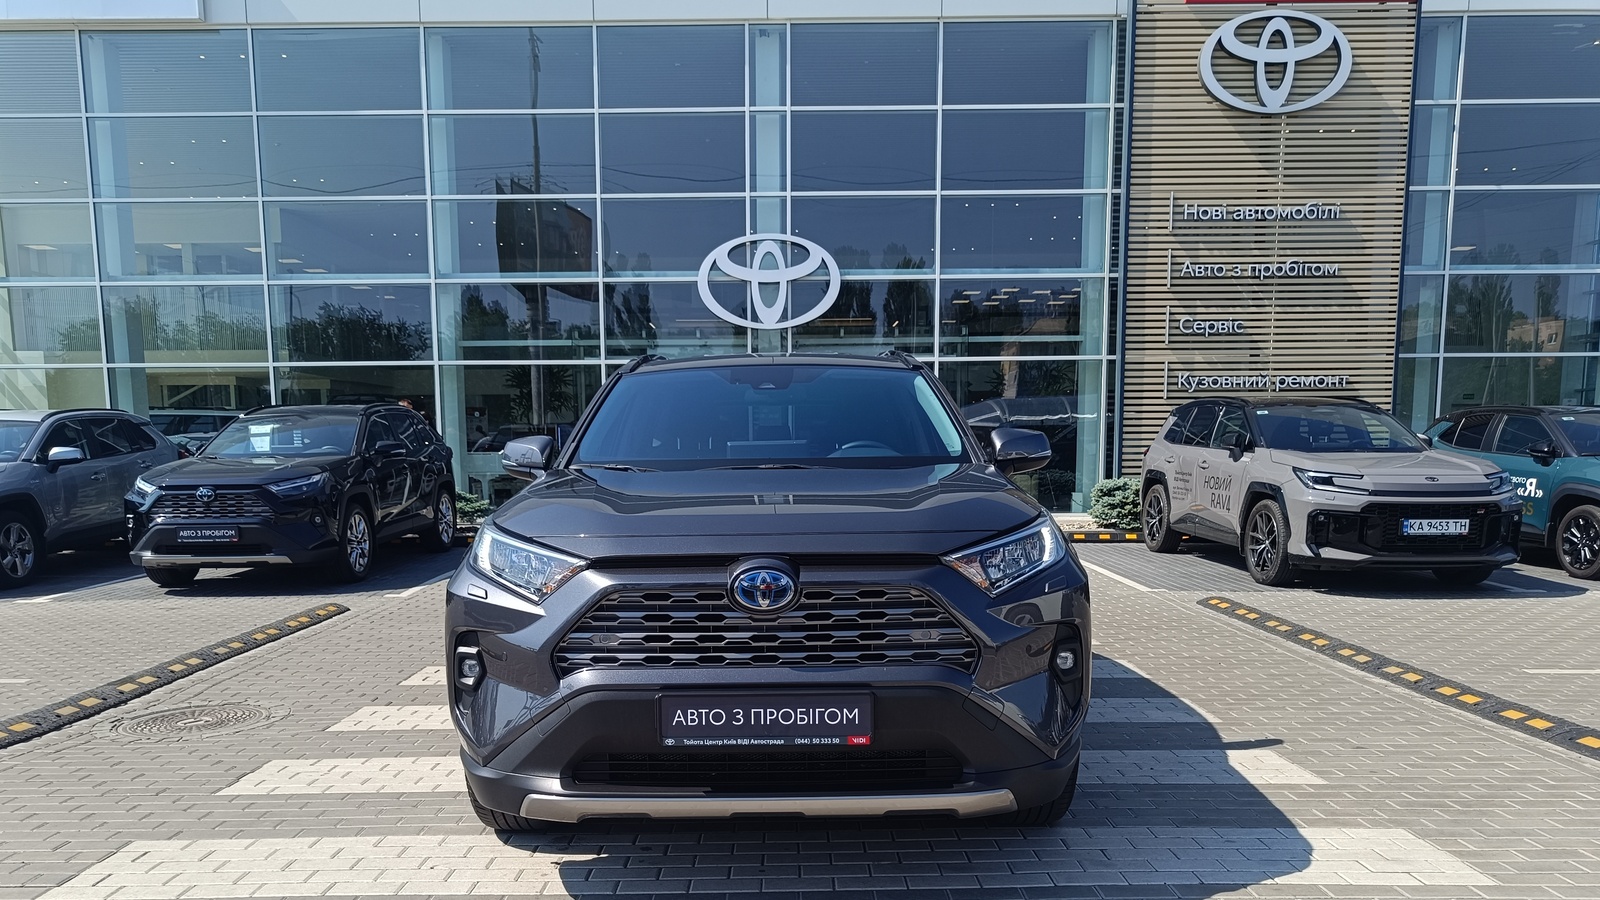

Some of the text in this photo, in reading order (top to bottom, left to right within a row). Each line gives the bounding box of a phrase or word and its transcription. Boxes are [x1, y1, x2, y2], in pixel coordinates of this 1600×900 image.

[1183, 202, 1341, 220] Нові автомобілі
[1180, 260, 1339, 281] Авто з пробігом
[1179, 316, 1244, 337] Сервіс
[1177, 372, 1349, 392] Кузовний ремонт
[1203, 475, 1232, 492] НОВИЙ
[1210, 492, 1231, 513] RAV4
[1427, 521, 1449, 531] 9453
[672, 708, 859, 726] АВТО З ПРОБІГОМ
[704, 738, 723, 746] Центр
